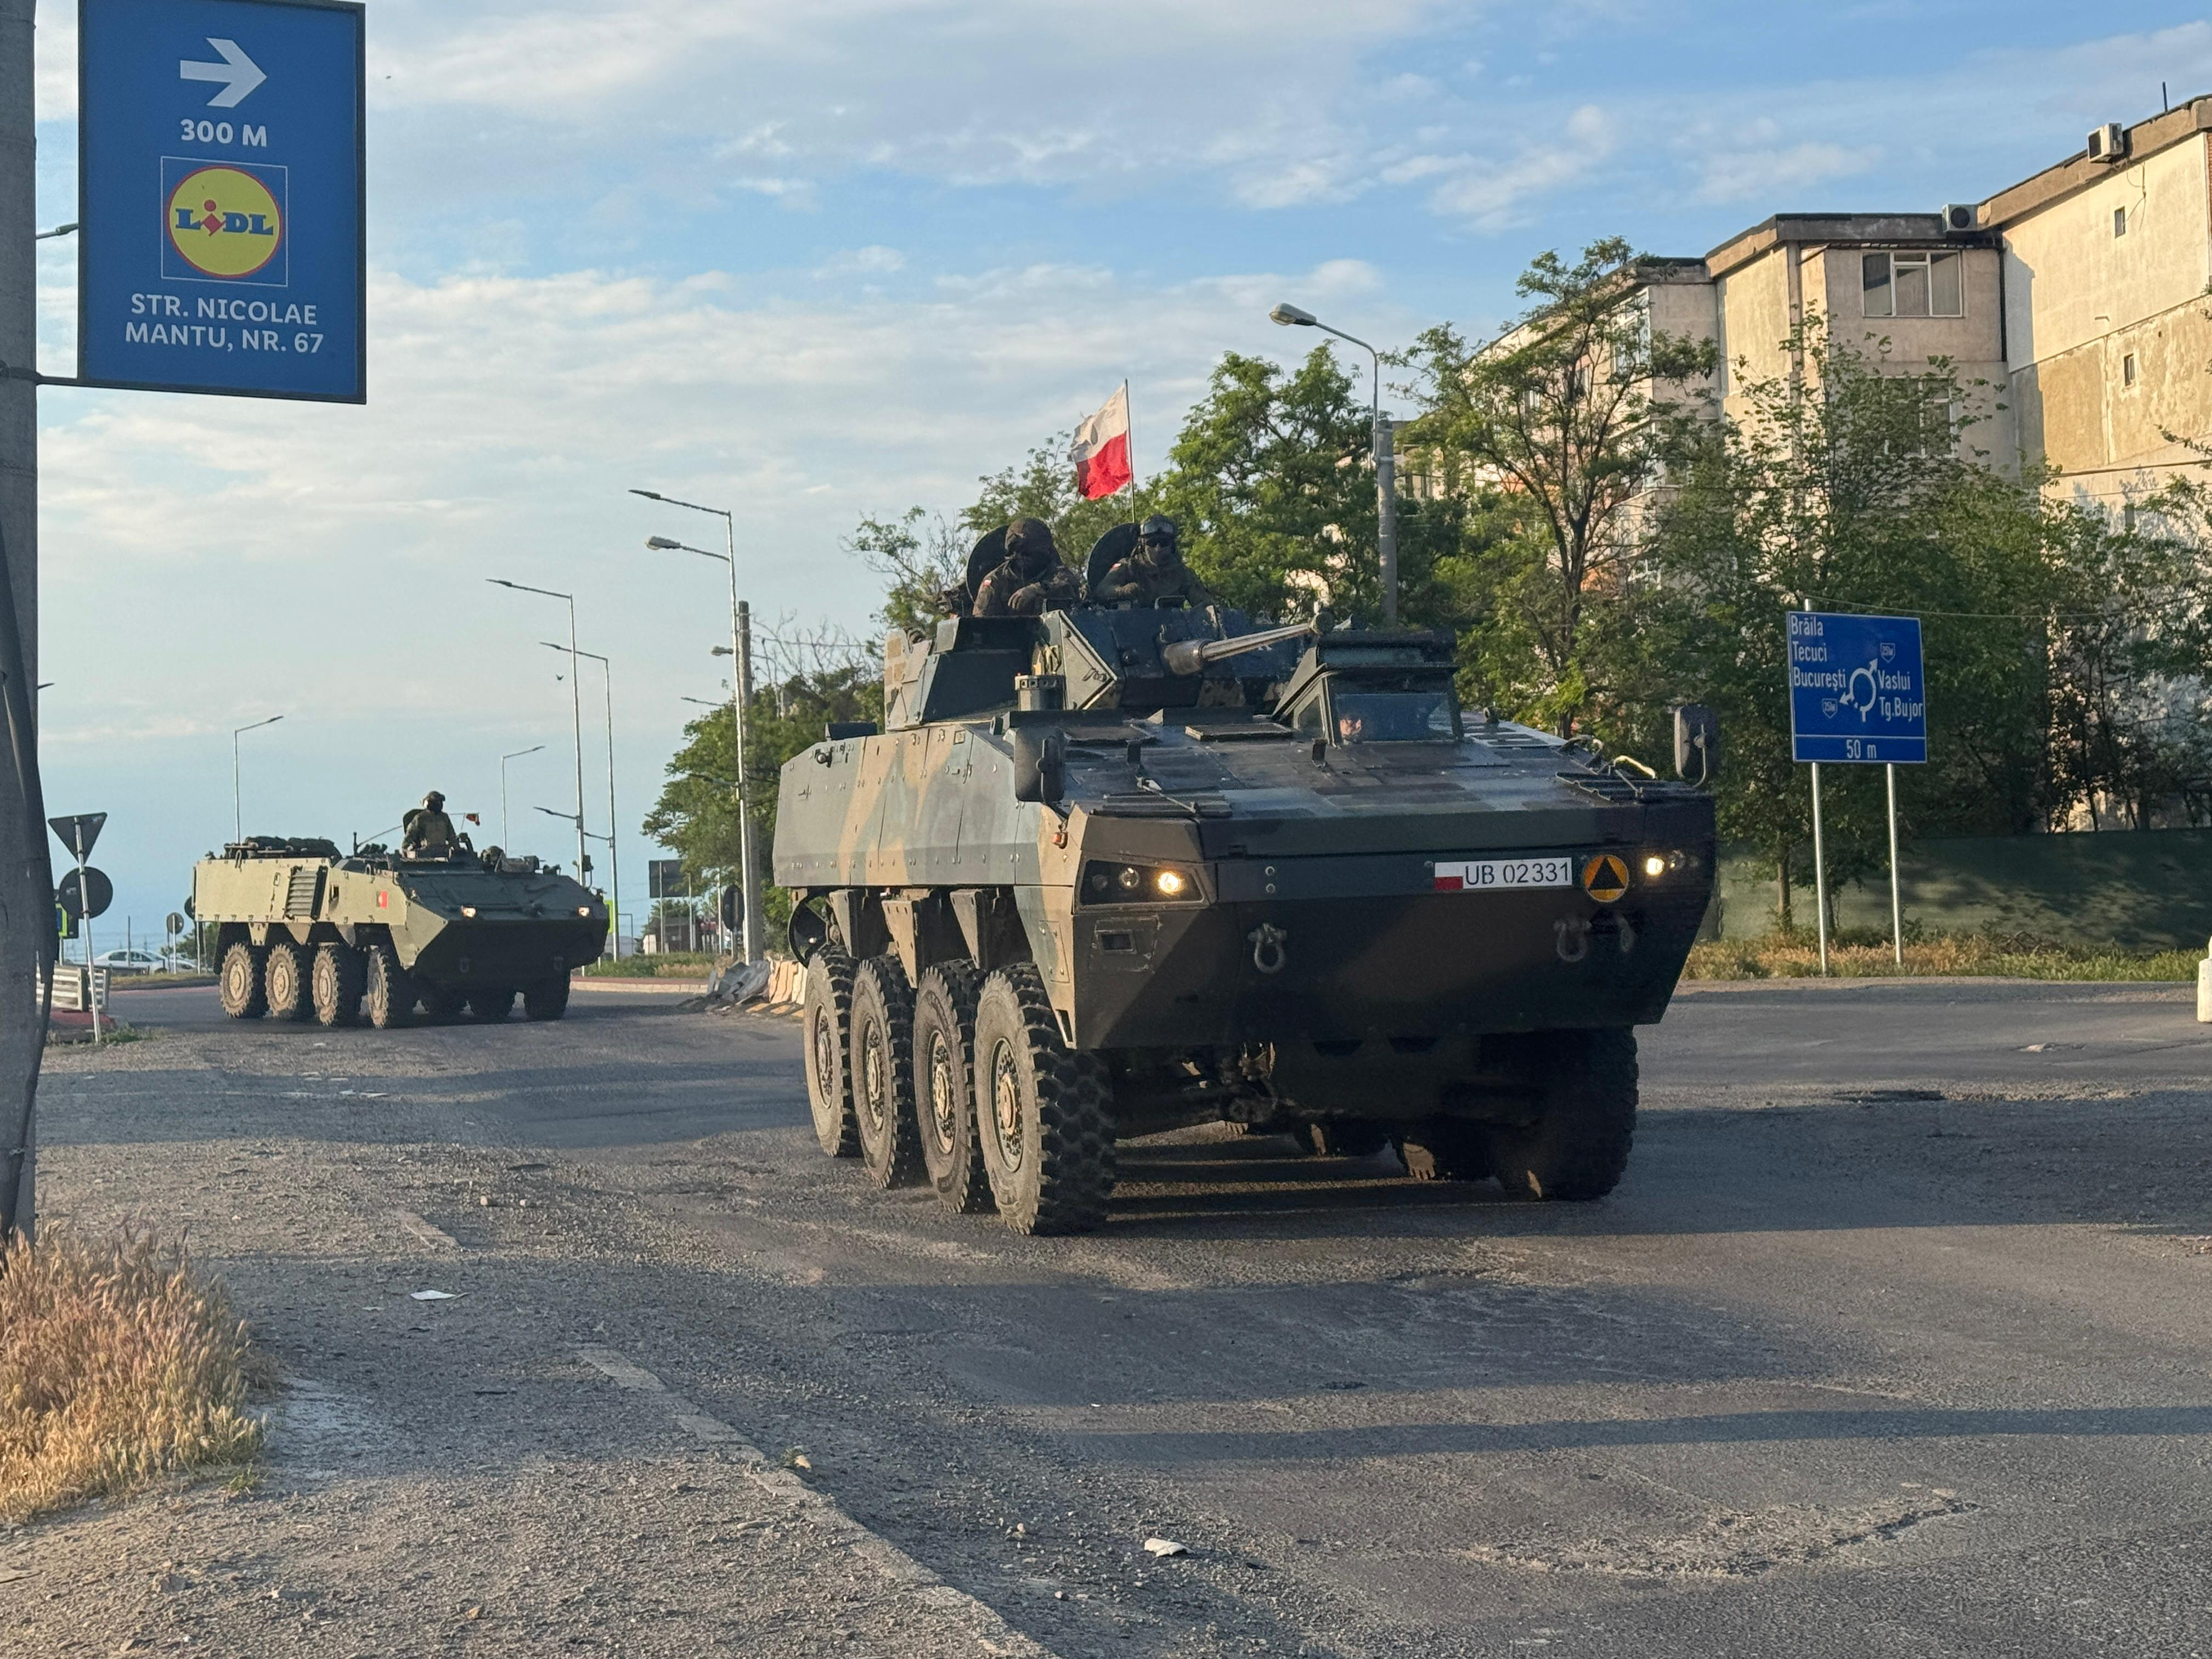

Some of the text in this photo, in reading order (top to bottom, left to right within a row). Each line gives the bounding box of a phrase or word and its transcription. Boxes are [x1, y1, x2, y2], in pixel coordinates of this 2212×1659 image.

[180, 120, 267, 147] 300 M
[132, 294, 317, 325] STR. NICOLAE
[126, 323, 324, 353] MANTU, NR. 67
[1792, 641, 1827, 662] Tecuci
[1878, 670, 1911, 690] Vaslui
[1847, 740, 1877, 759] 50 m
[1465, 862, 1569, 885] UB 02331
